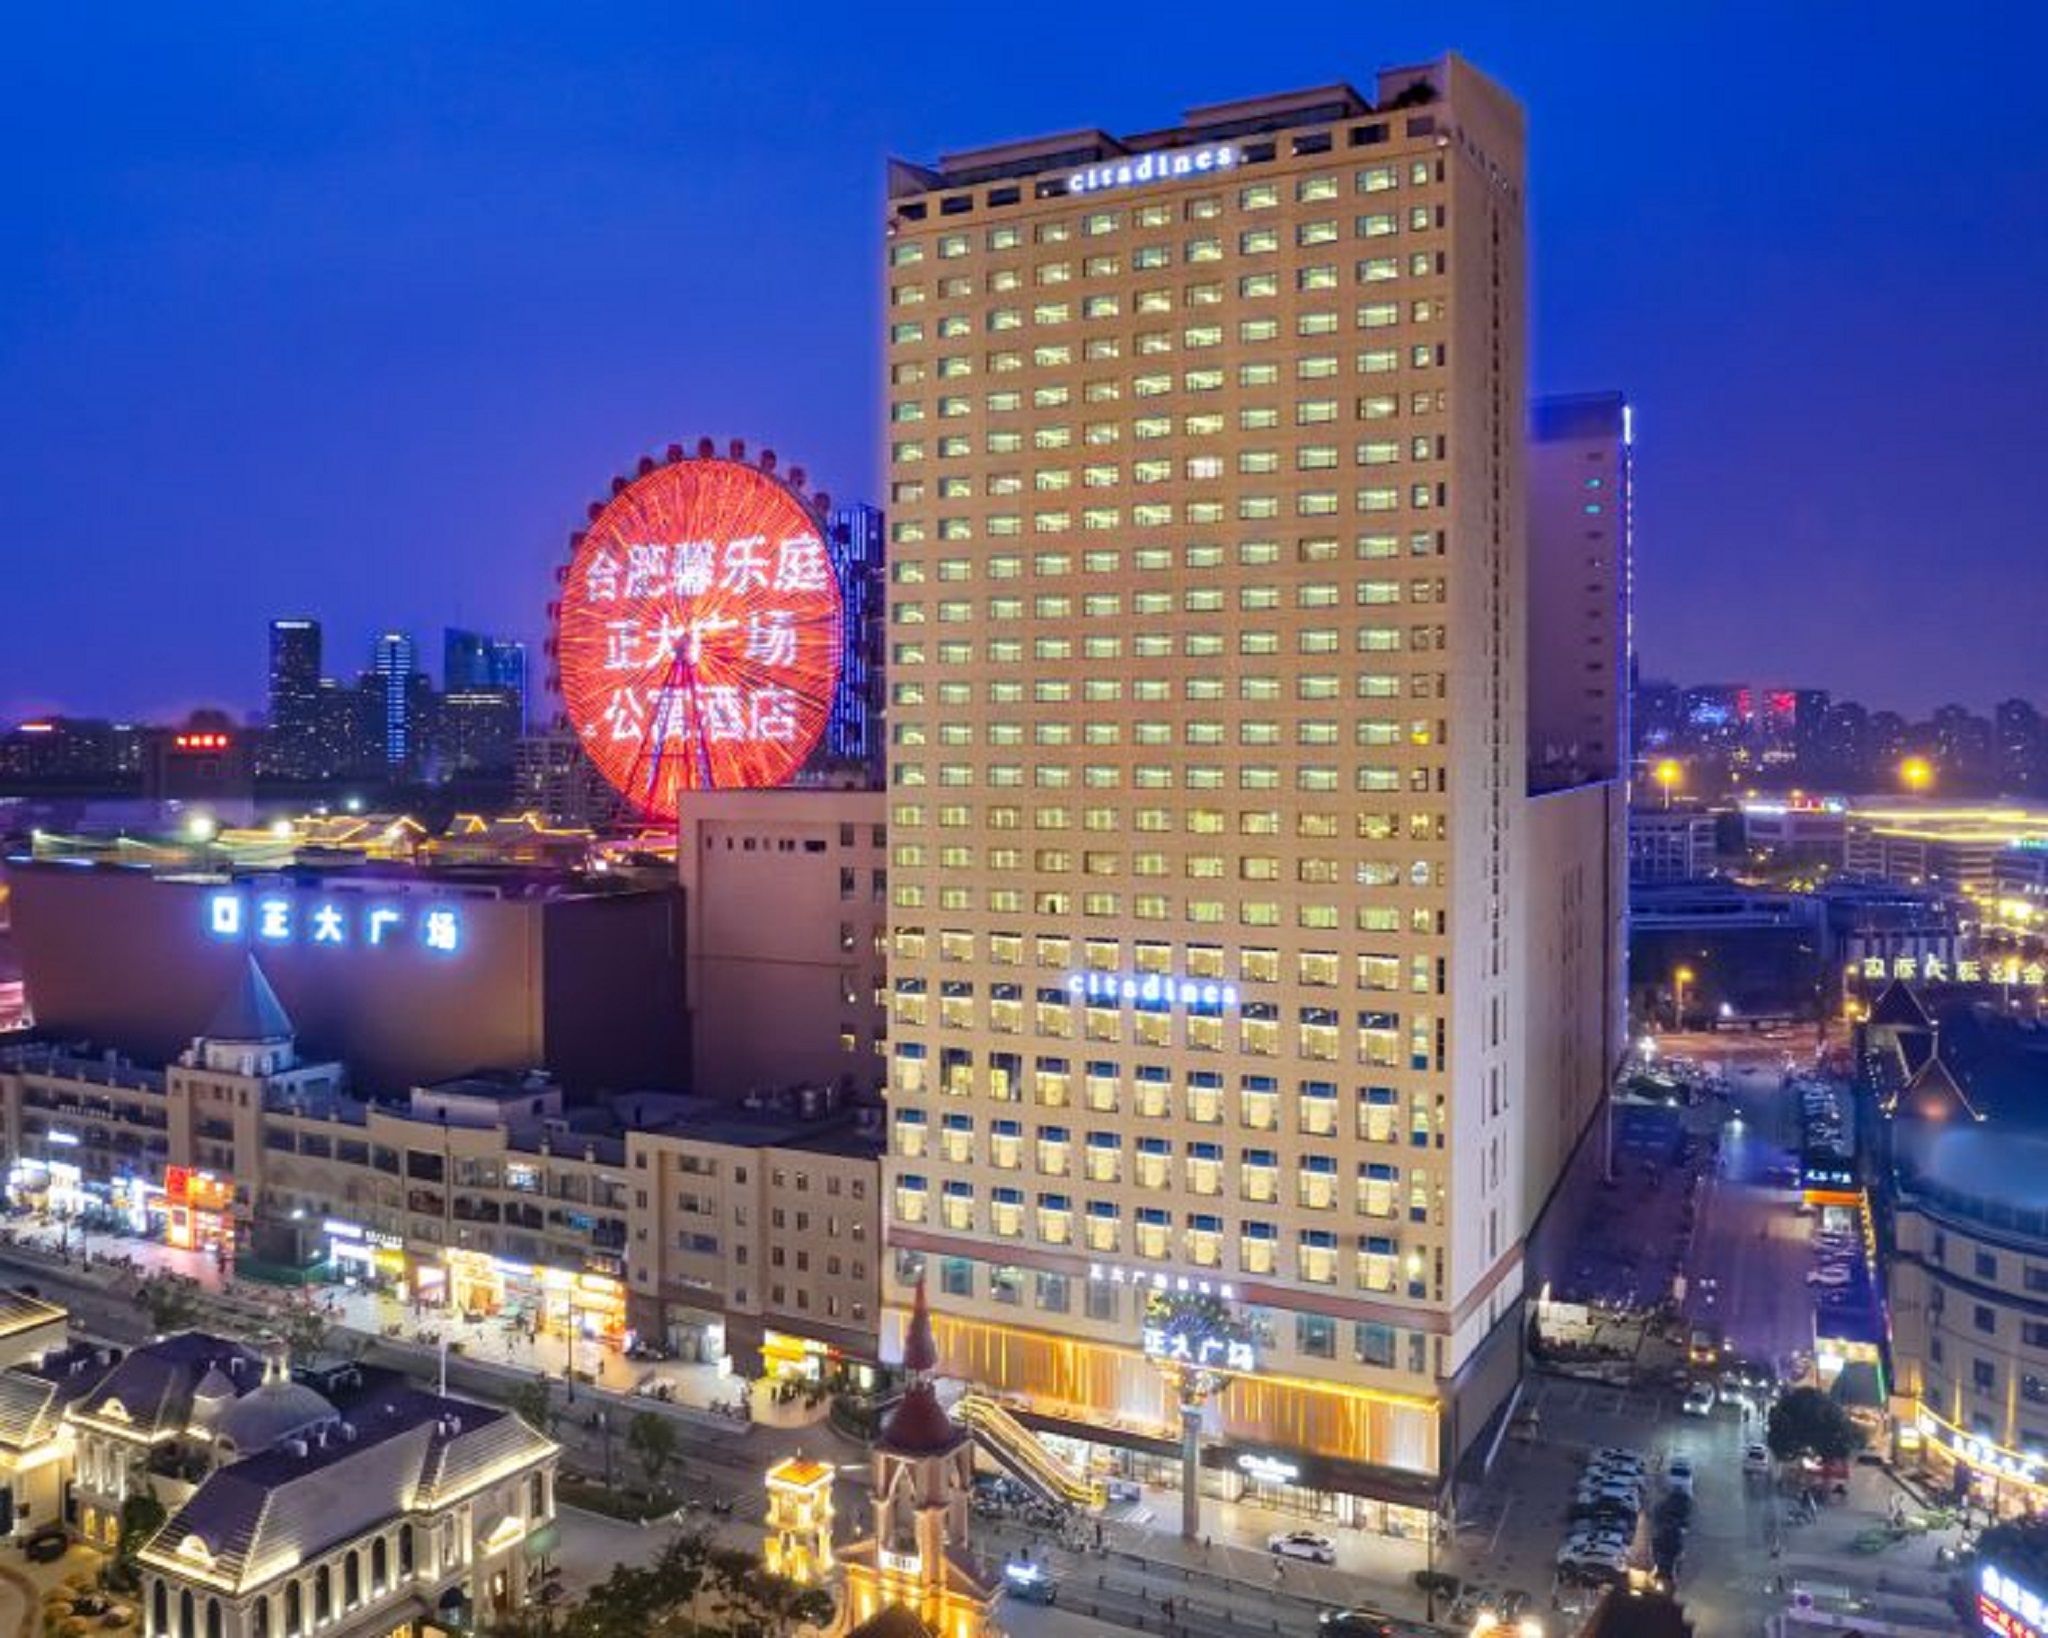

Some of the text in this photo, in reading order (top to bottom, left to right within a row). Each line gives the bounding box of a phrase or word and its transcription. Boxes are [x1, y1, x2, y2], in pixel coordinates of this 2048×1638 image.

[1068, 146, 1233, 193] citadines
[603, 610, 798, 669] 正大广场
[260, 900, 457, 950] 正大广场
